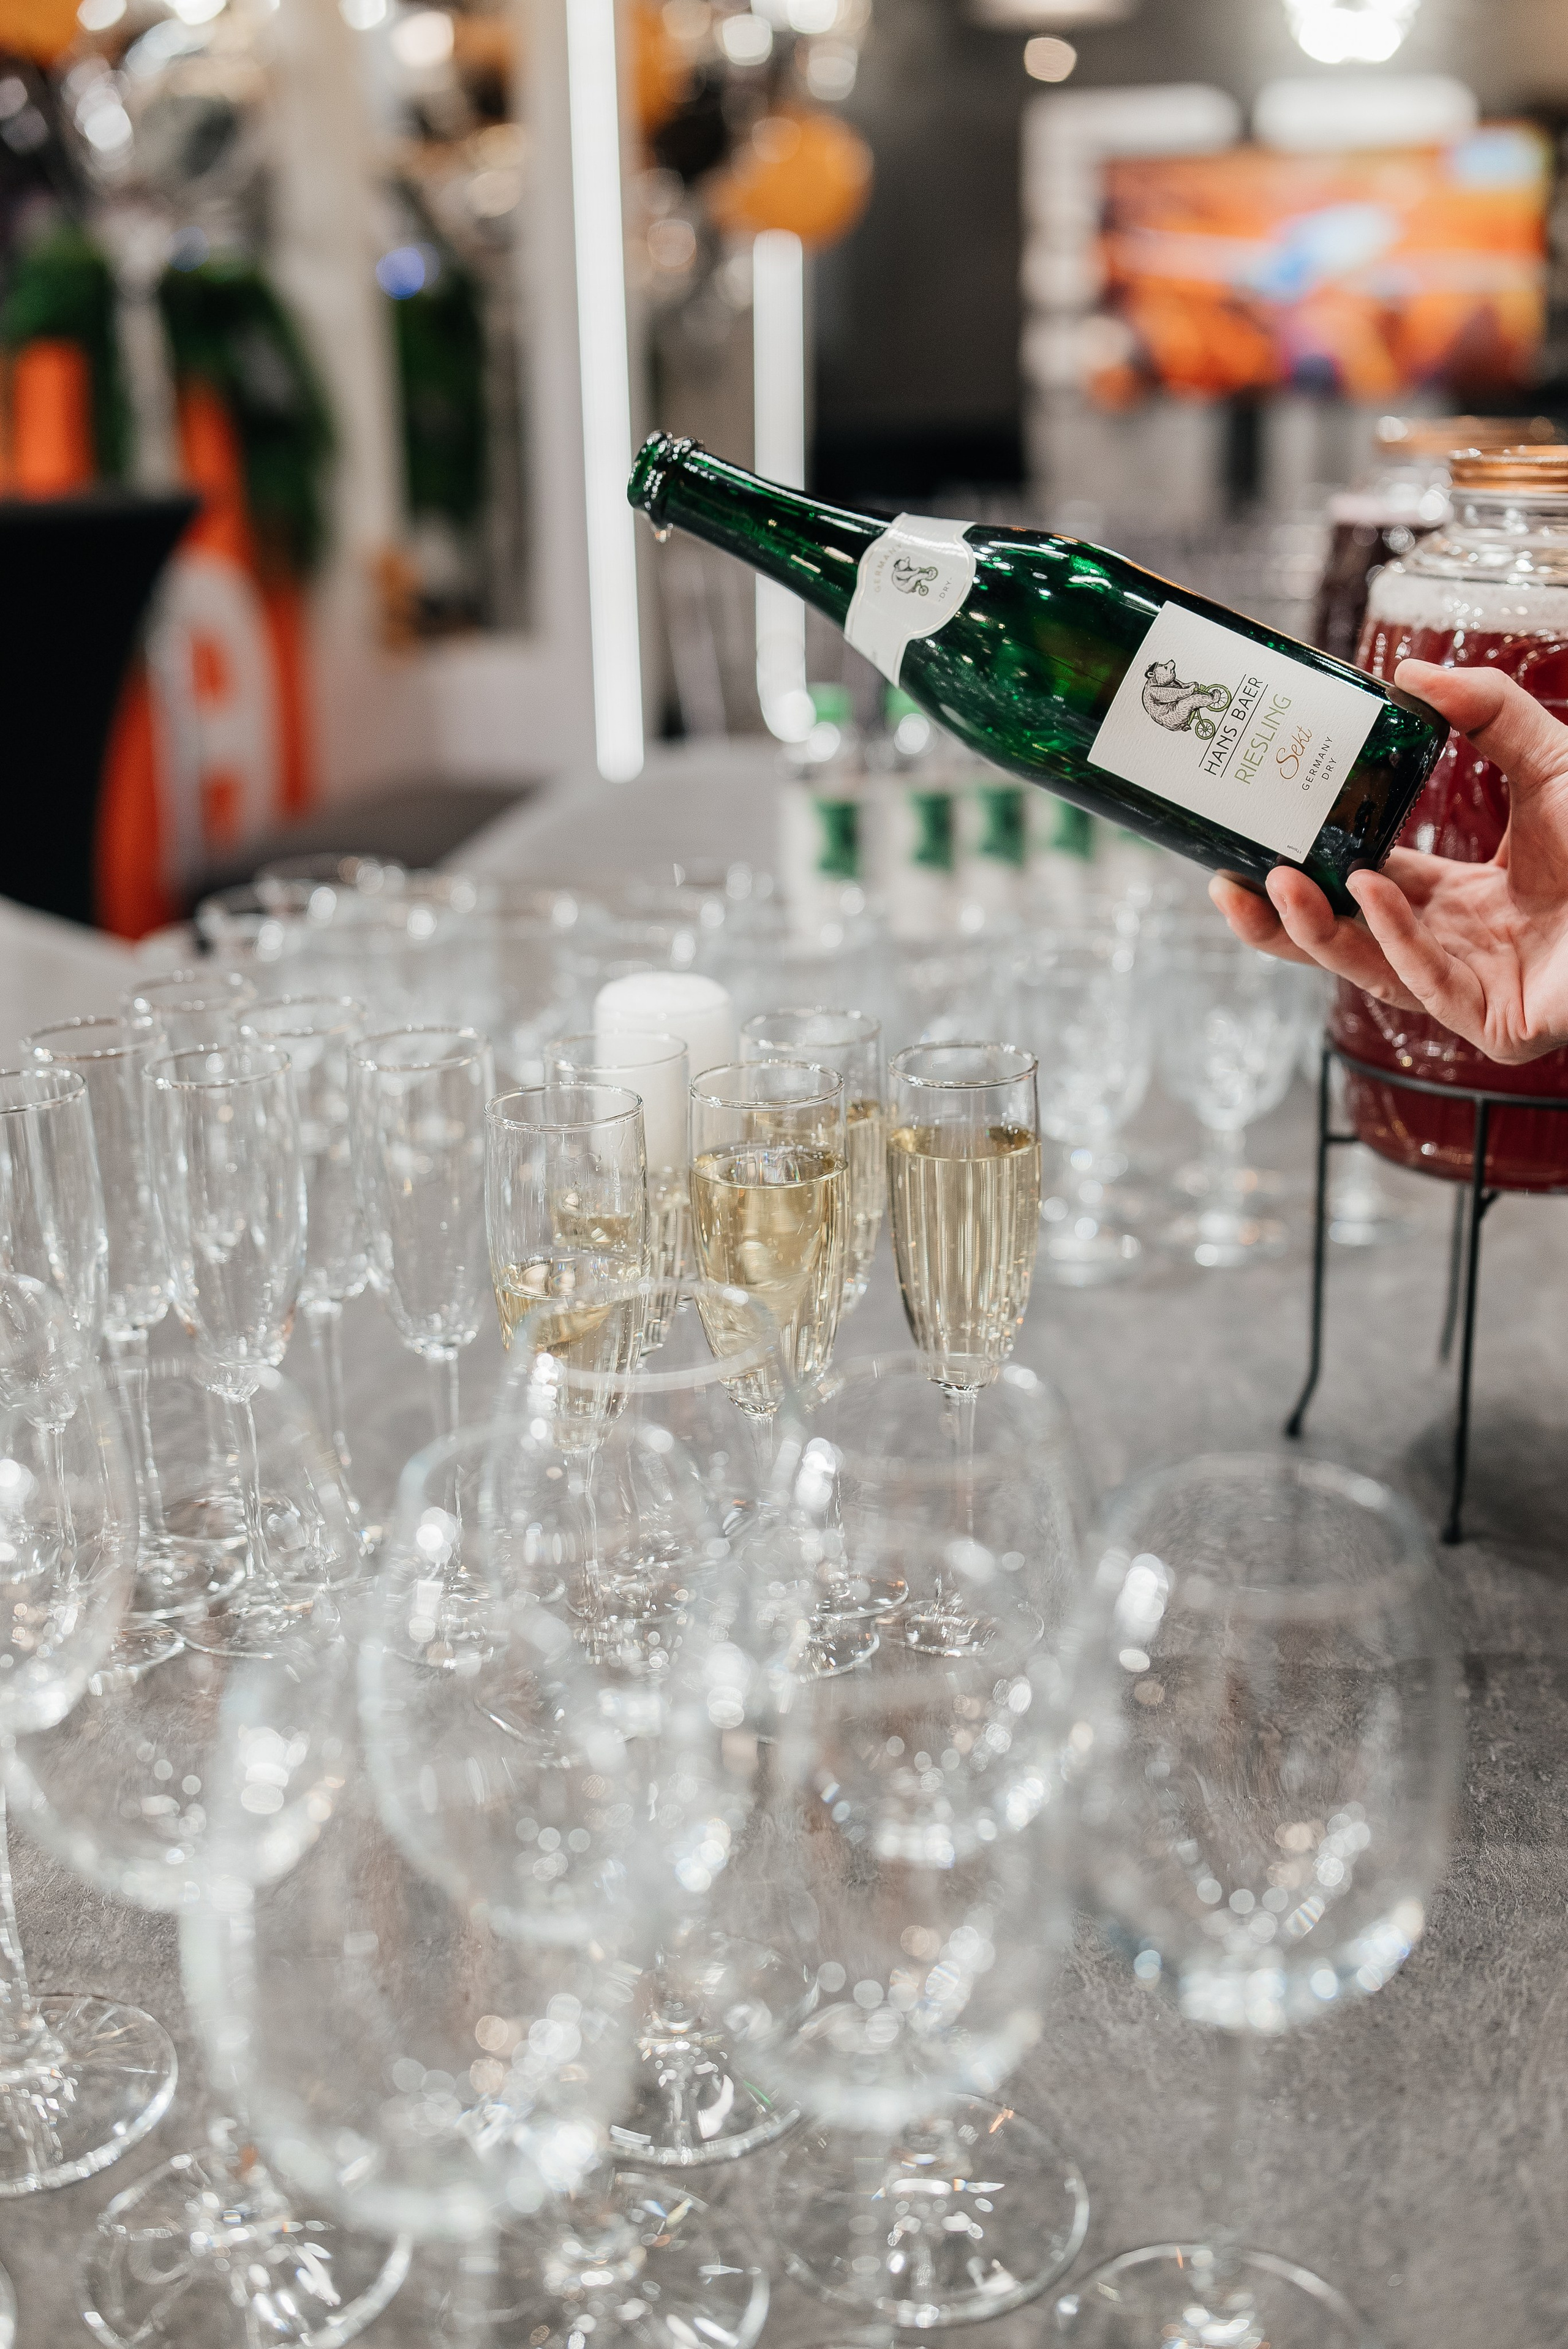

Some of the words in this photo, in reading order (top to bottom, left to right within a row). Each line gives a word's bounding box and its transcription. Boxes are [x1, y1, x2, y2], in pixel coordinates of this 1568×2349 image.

[874, 544, 902, 592] GERMANY
[1204, 725, 1237, 775] HANS
[1231, 677, 1263, 721] BAER
[1234, 693, 1292, 785] RIESLING
[1276, 725, 1313, 780] Sekt
[1302, 736, 1333, 791] GERMANY
[1321, 757, 1337, 781] DRY
